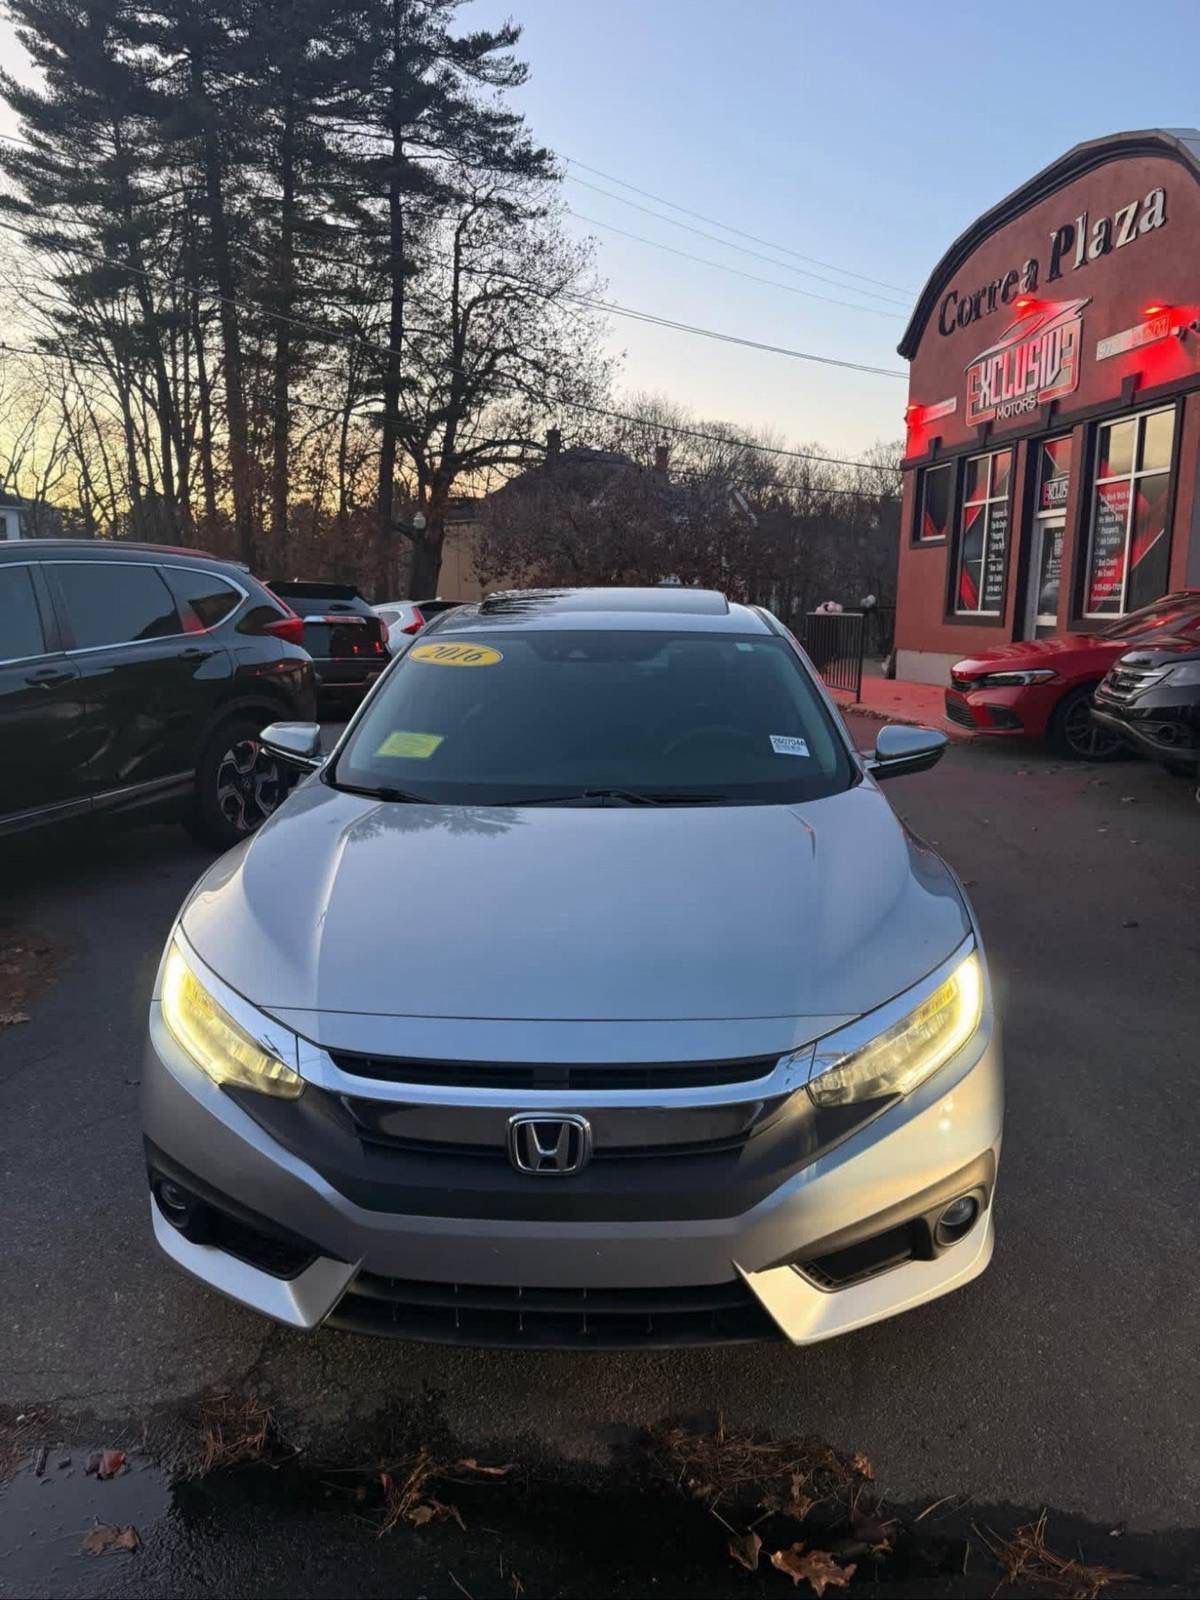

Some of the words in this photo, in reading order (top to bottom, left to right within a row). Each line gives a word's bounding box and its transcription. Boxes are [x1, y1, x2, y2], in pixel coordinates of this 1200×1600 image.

[938, 258, 1039, 336] Correa
[1046, 186, 1167, 283] Plaza
[966, 314, 1081, 426] EXCLUSIVE
[996, 395, 1037, 420] MOTORS
[419, 646, 488, 662] 2016
